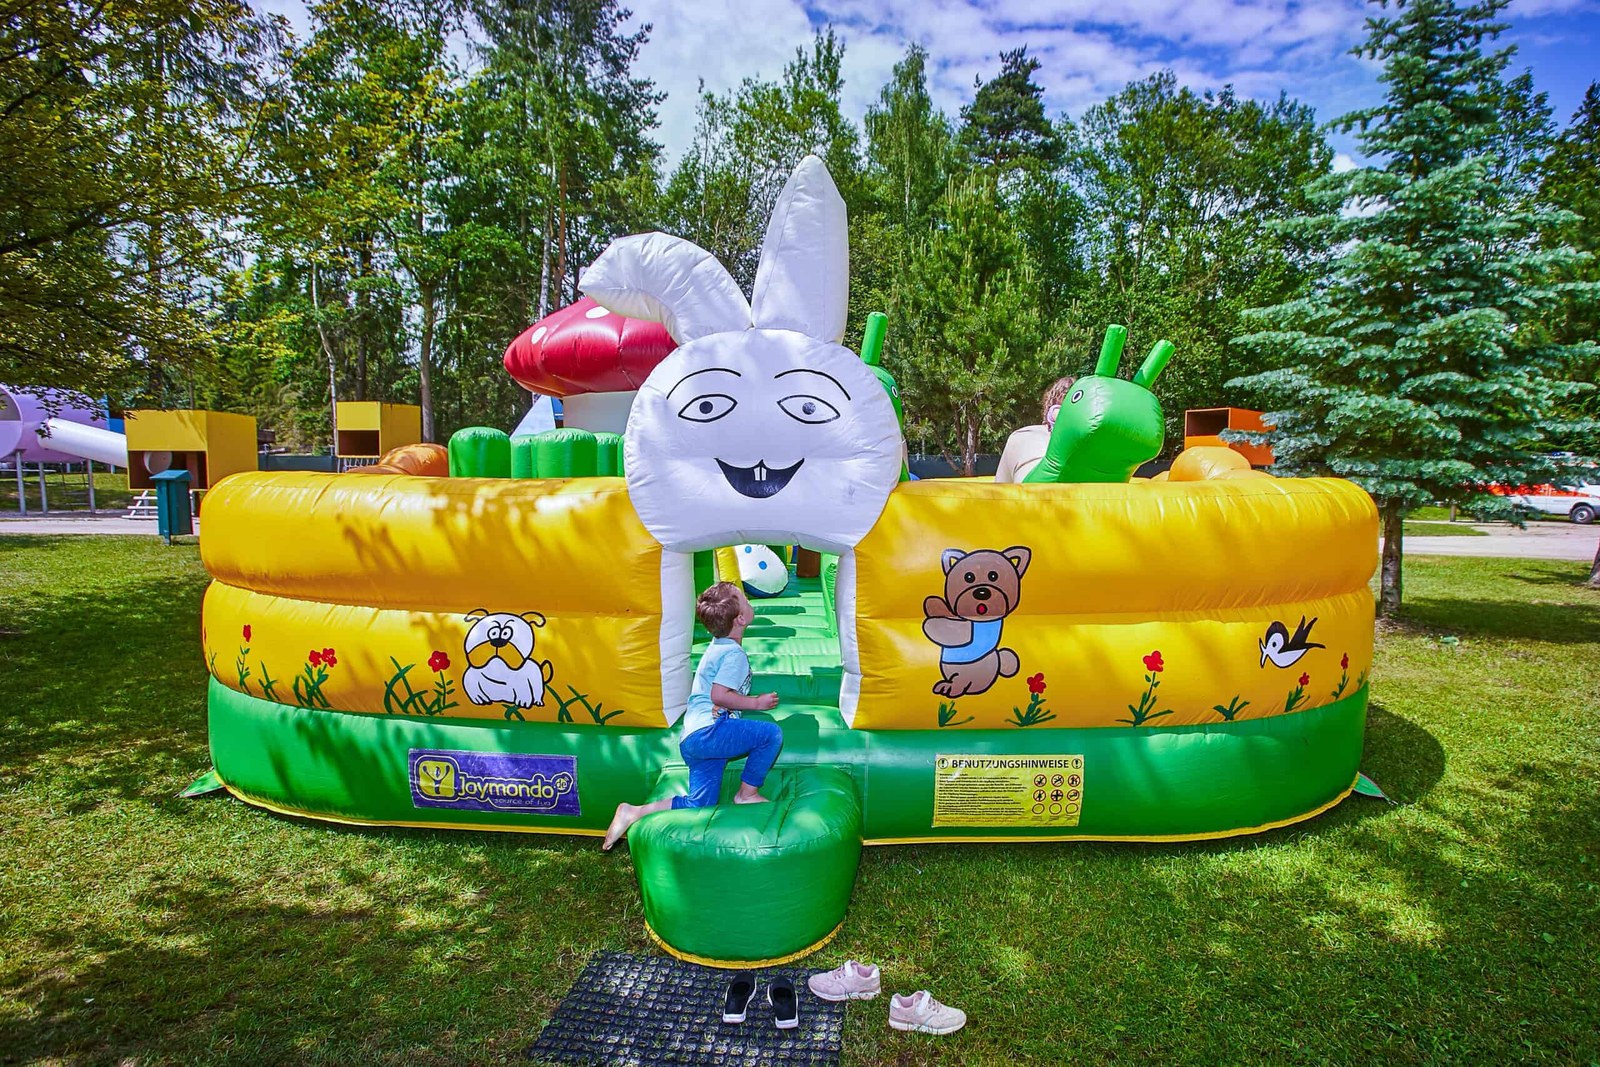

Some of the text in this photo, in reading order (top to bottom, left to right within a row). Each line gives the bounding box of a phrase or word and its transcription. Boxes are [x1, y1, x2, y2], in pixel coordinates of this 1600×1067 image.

[951, 759, 1069, 769] BENUTZUNGSHINWEISE
[458, 776, 554, 798] Joymondo
[524, 797, 535, 805] of
